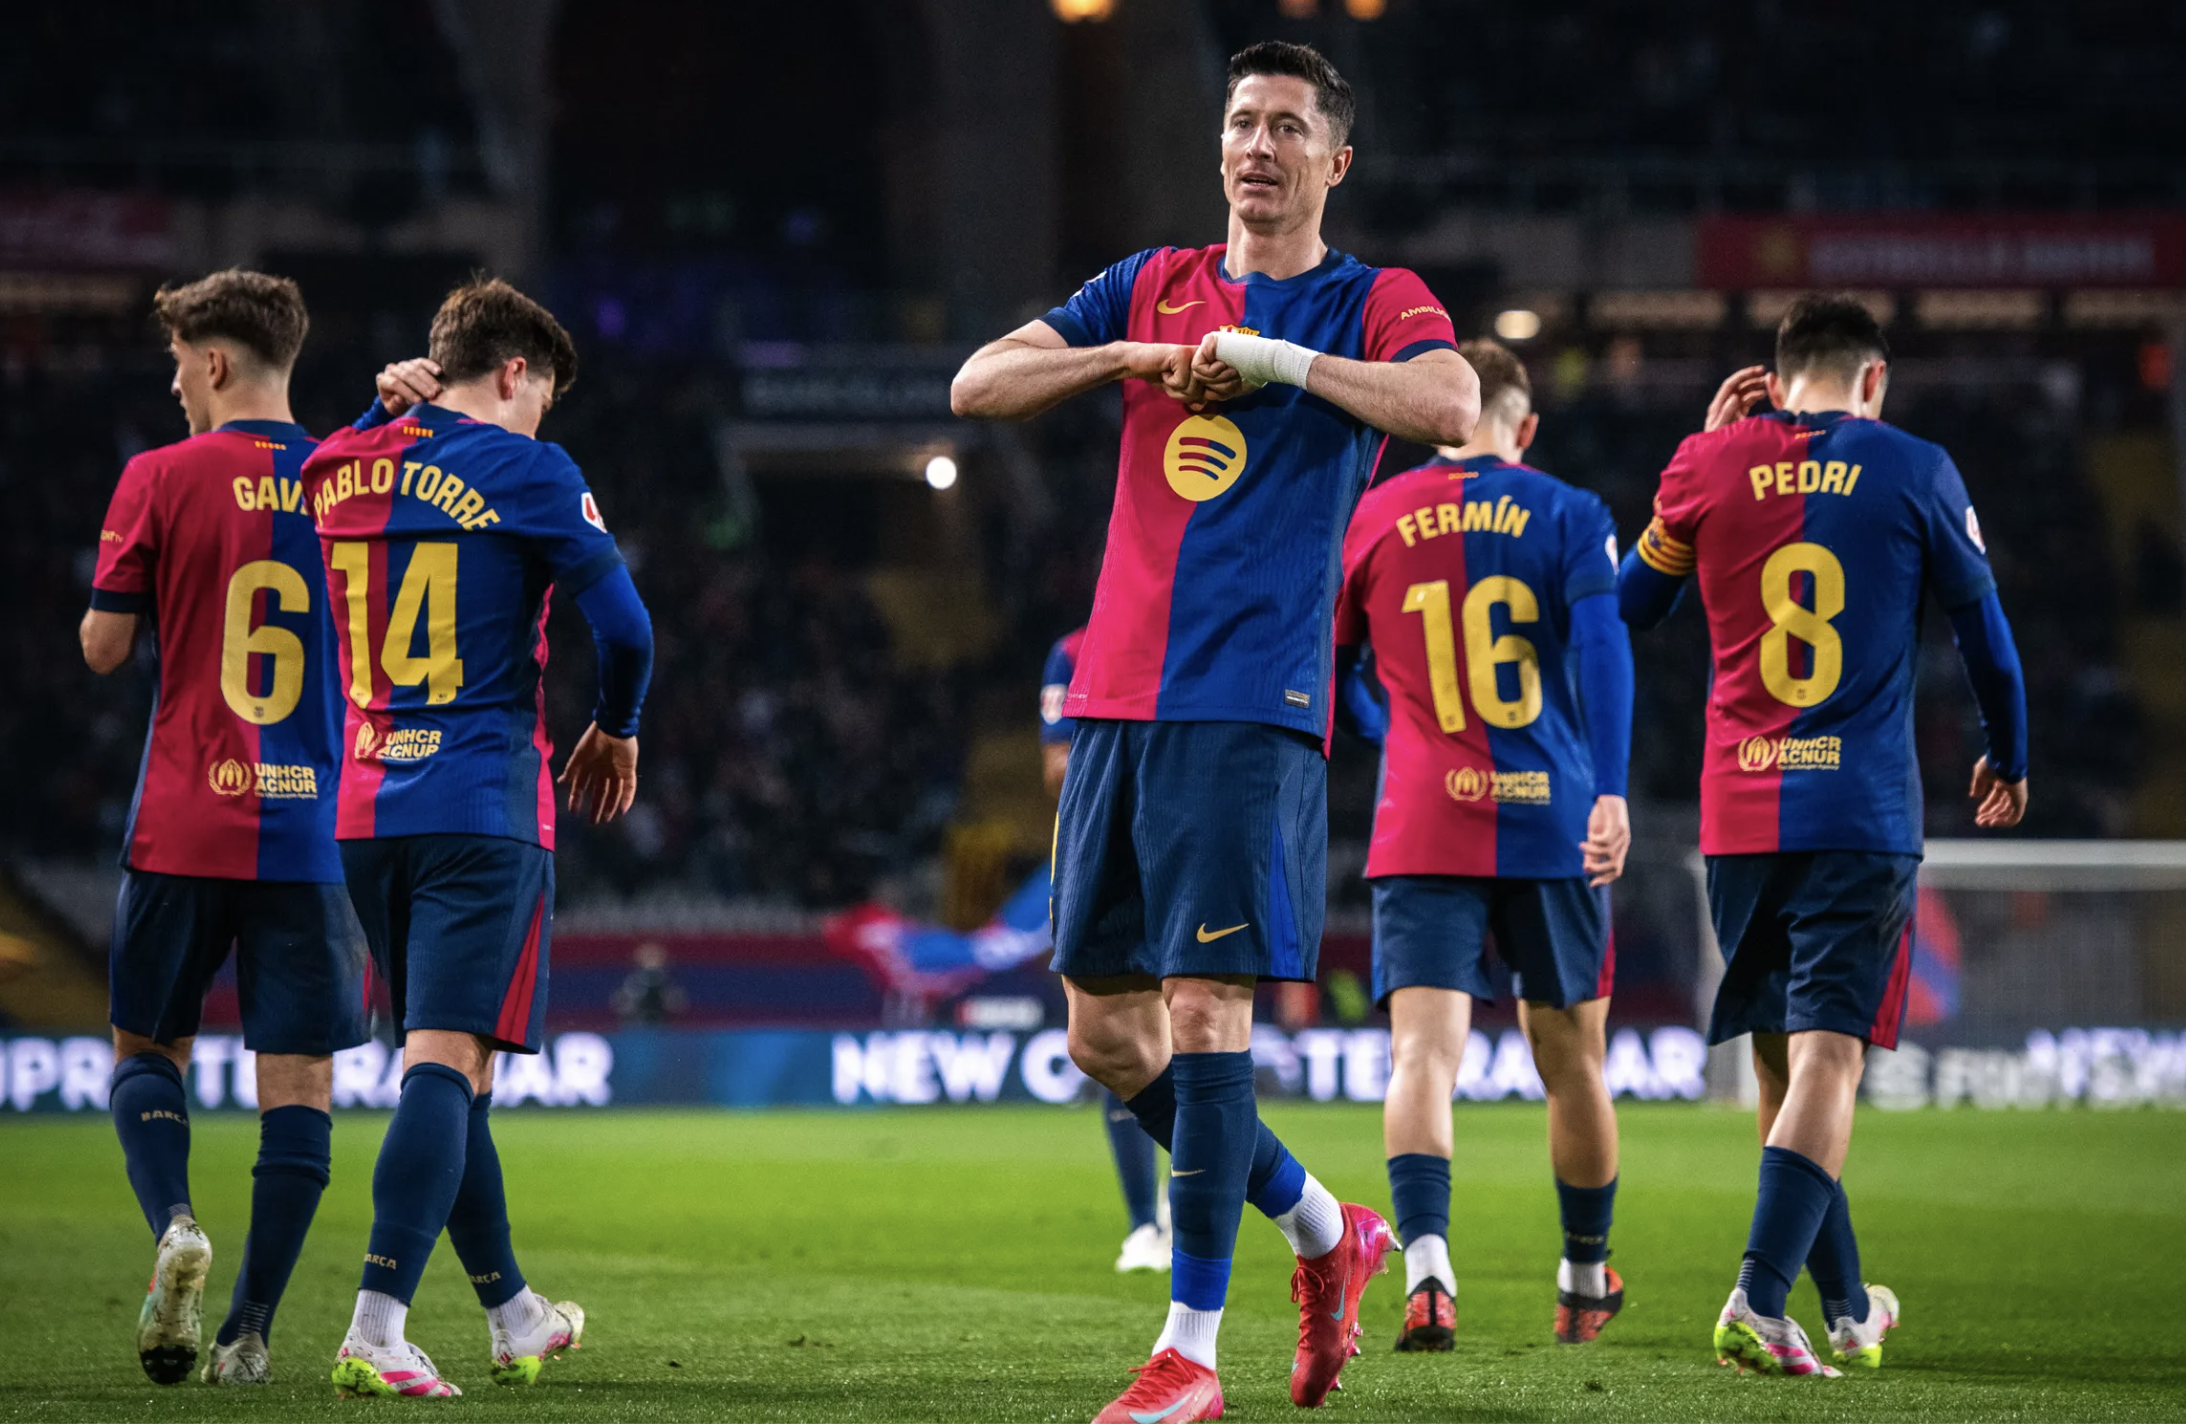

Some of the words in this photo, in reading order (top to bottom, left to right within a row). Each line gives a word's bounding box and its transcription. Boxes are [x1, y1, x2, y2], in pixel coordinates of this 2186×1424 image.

[232, 475, 309, 516] GAV
[313, 457, 395, 529] PABLO
[400, 460, 501, 532] TORRE
[1748, 460, 1862, 501] PEDRI
[1396, 495, 1531, 548] FERMÍN
[220, 559, 311, 725] 6
[330, 541, 464, 709] 14
[1759, 541, 1845, 708] 8
[1402, 575, 1543, 734] 16
[385, 729, 442, 745] UNHCR
[1776, 749, 1841, 764] ACNUR
[253, 776, 318, 793] ACNUR
[254, 762, 316, 780] UNHCR
[830, 1029, 1016, 1104] NEW
